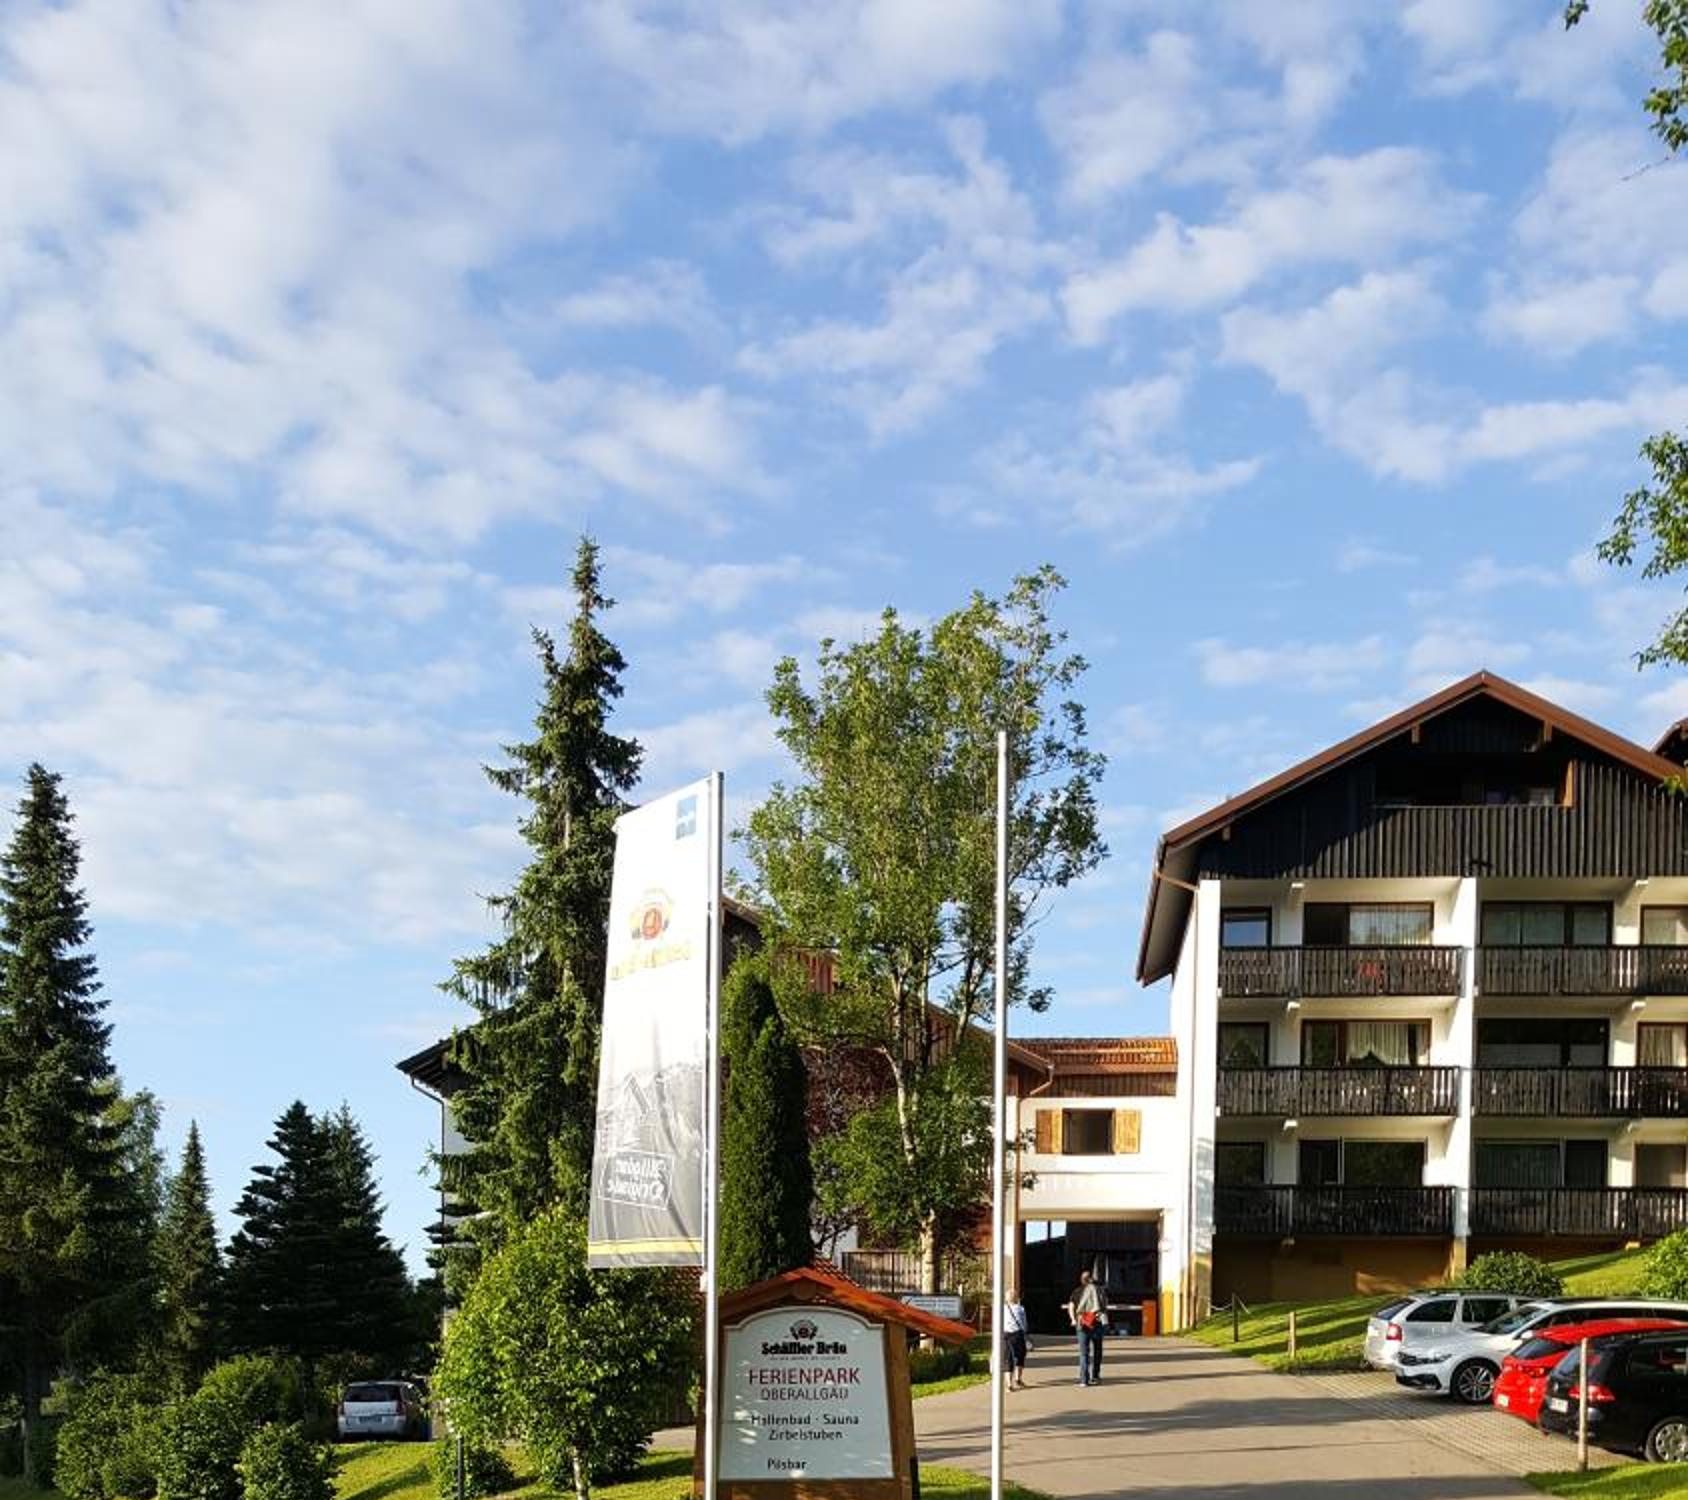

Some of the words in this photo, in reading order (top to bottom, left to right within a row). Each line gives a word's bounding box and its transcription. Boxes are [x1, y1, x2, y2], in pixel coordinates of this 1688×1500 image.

[816, 1341, 848, 1355] Bräu
[748, 1367, 861, 1385] FERIENPARK
[751, 1413, 812, 1426] Hallenbad
[822, 1412, 860, 1425] Sauna
[768, 1429, 843, 1441] Zirbelstuben
[767, 1458, 808, 1470] Pilsbar
